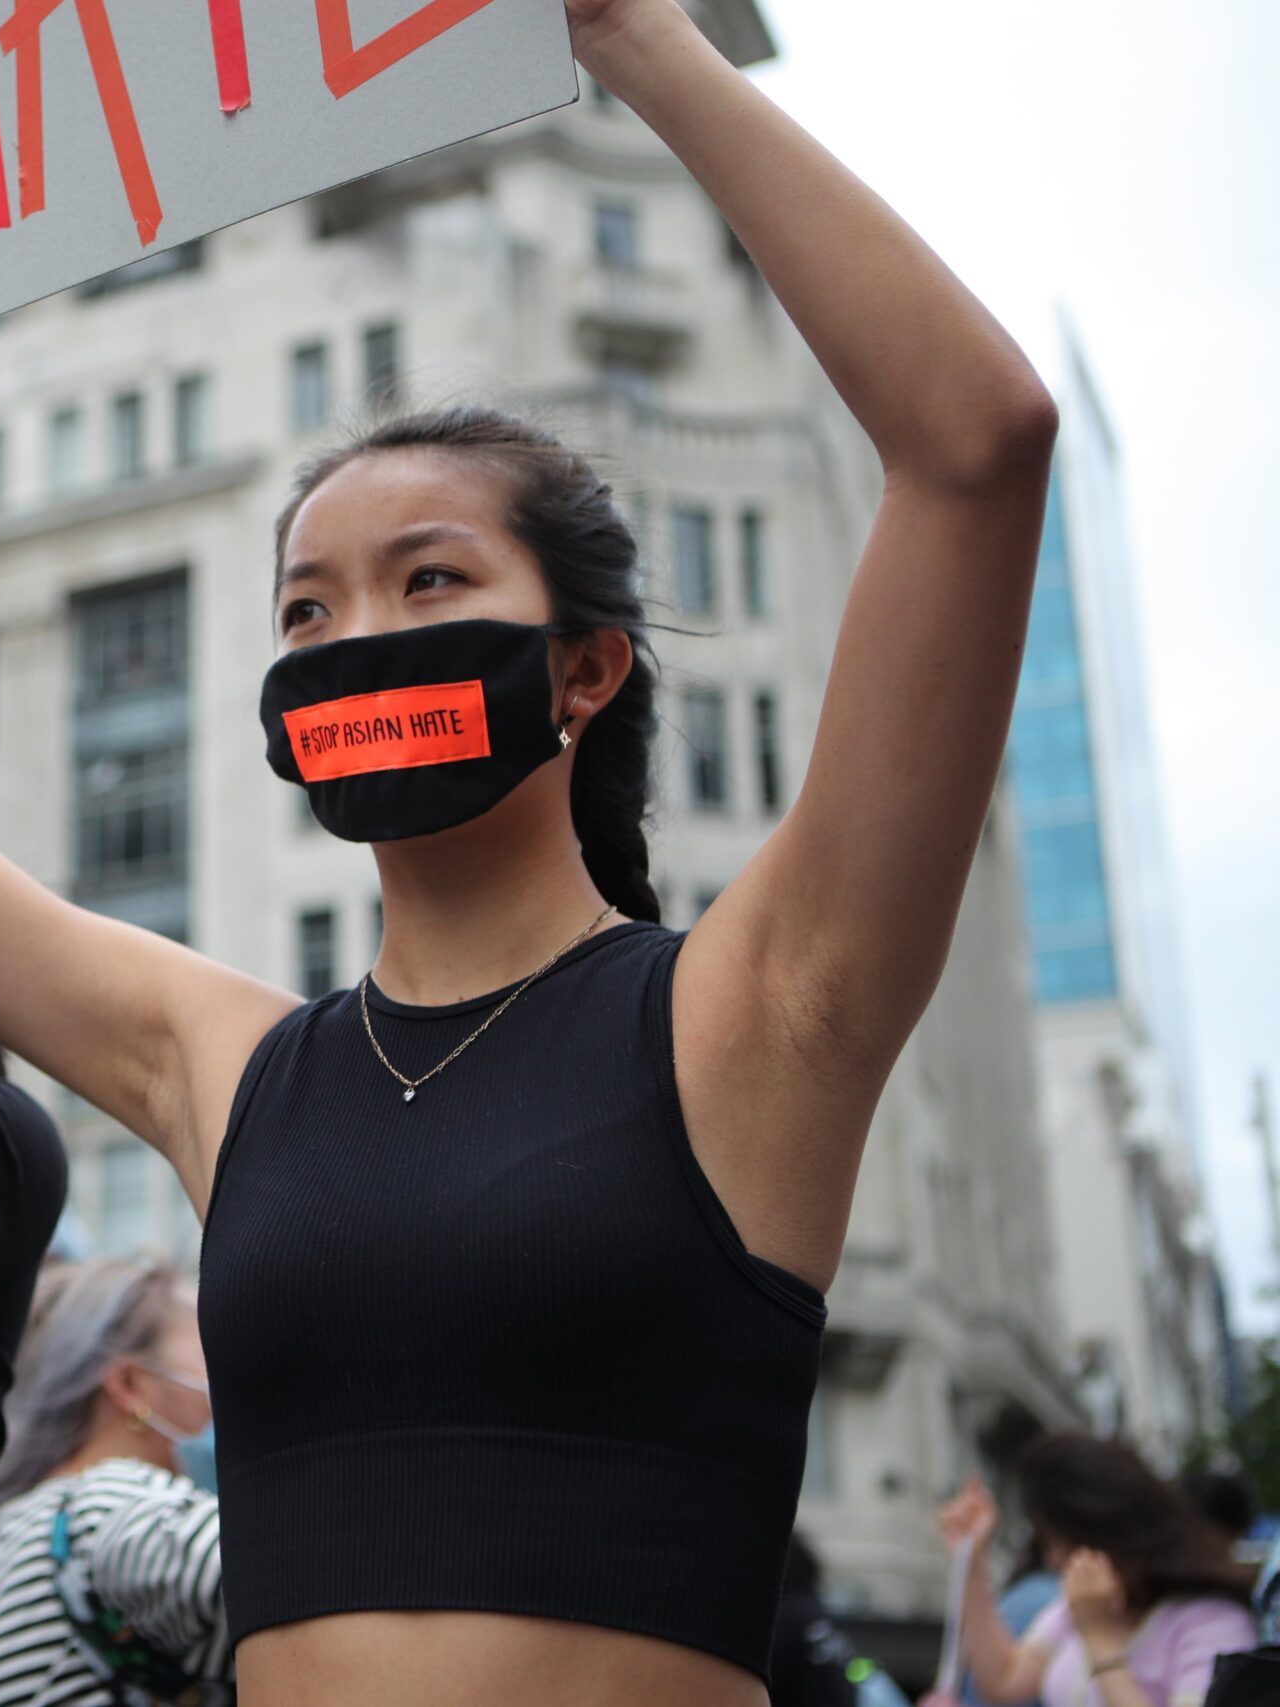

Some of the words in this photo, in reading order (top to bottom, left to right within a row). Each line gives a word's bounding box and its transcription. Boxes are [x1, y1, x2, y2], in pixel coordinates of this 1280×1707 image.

[300, 723, 339, 757] #STOP
[343, 715, 403, 747] ASIAN
[410, 709, 464, 738] HATE
